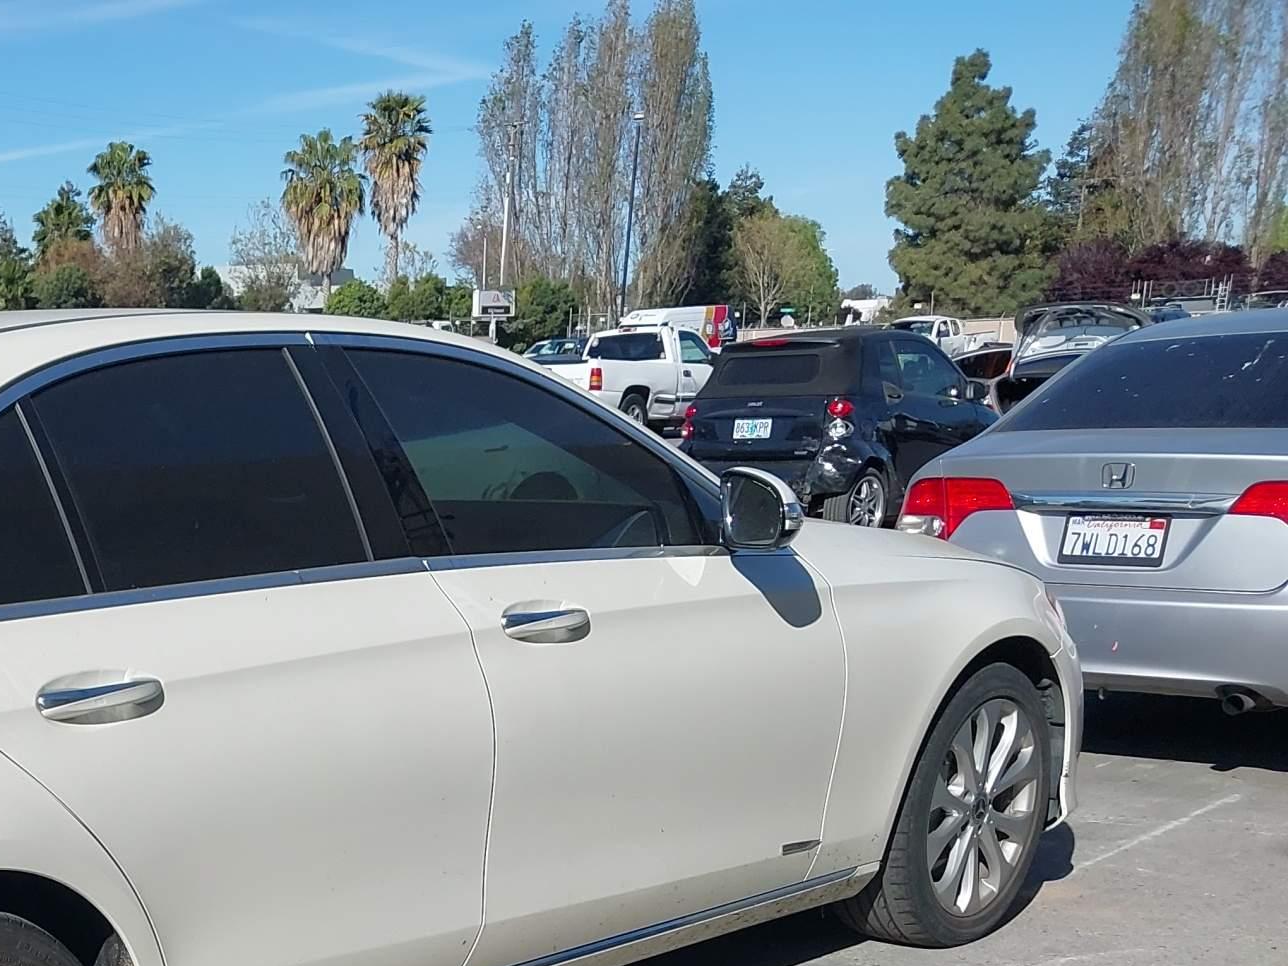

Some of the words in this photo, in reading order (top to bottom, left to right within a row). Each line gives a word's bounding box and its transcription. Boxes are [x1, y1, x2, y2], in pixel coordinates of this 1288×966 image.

[735, 422, 750, 434] 863
[1087, 519, 1143, 531] California
[1070, 532, 1158, 557] 7WLD168
